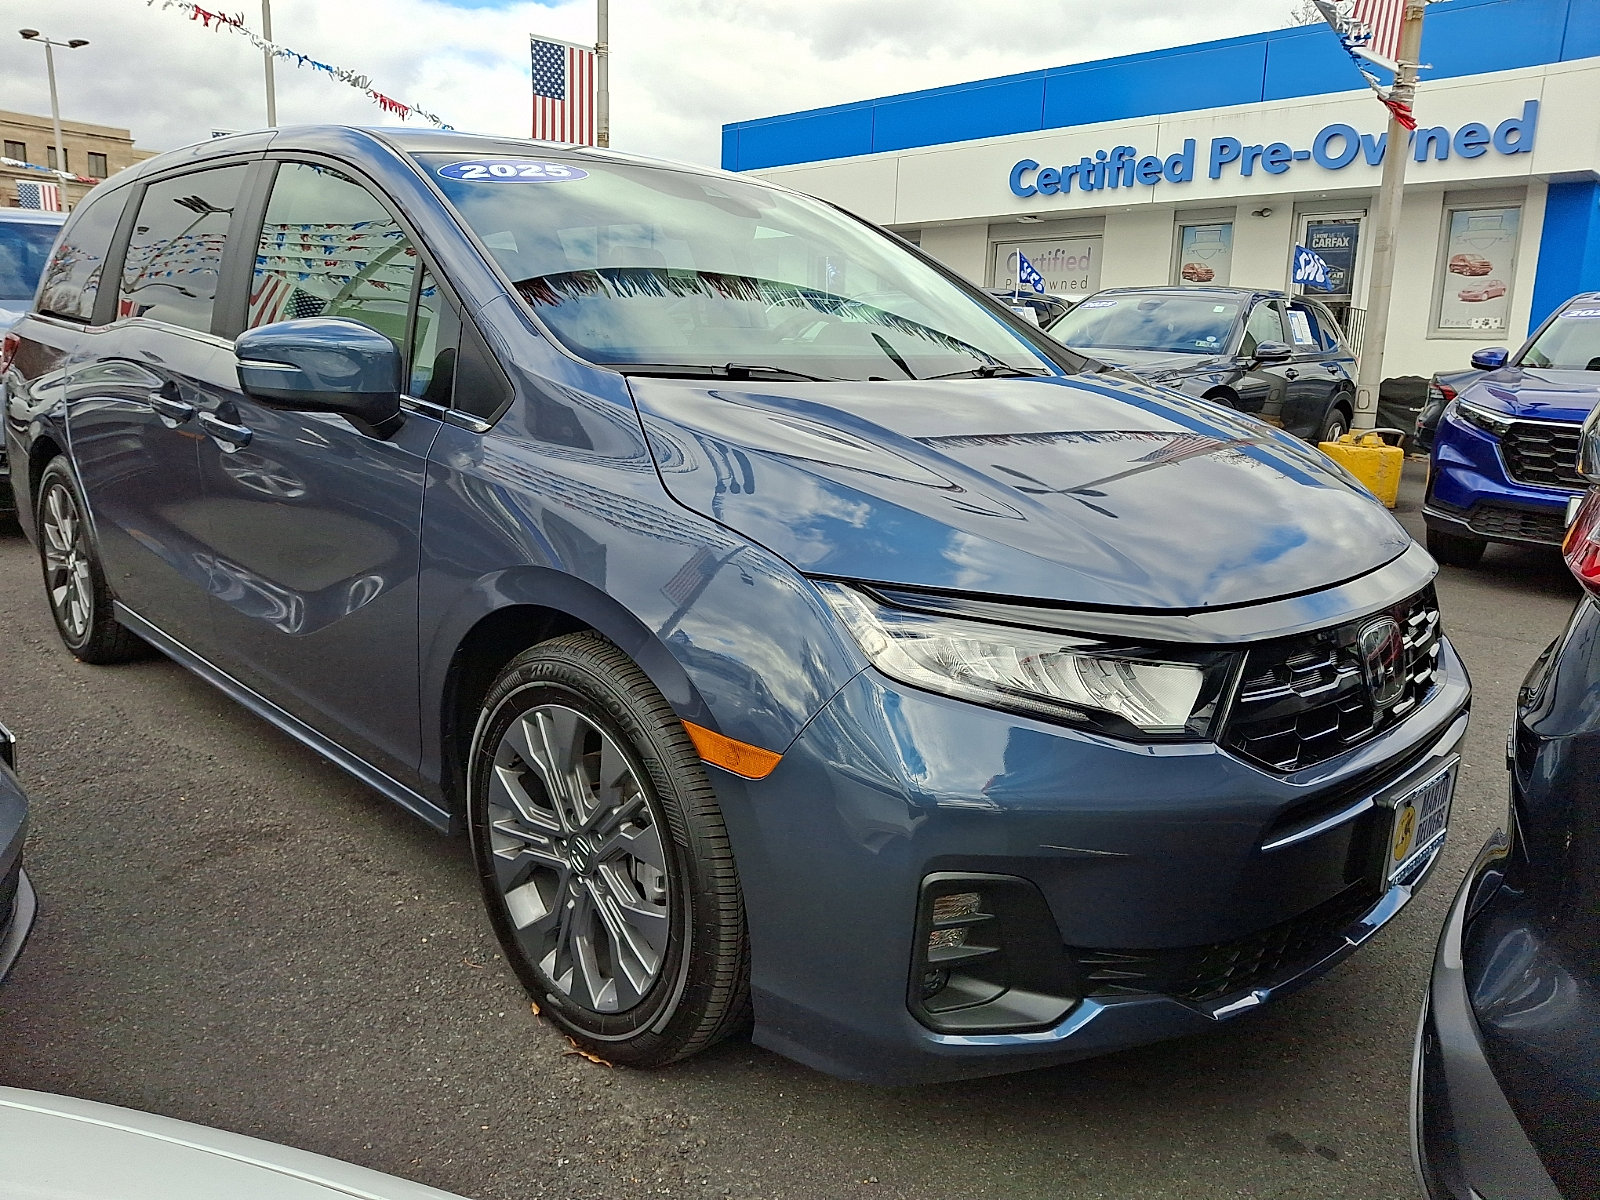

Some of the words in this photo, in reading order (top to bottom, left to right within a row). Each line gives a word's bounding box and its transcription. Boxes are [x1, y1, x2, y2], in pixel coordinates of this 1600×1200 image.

[1009, 138, 1196, 197] Certified
[1209, 99, 1539, 180] Pre-Owned
[459, 164, 572, 179] 2025
[1312, 237, 1350, 248] CARFAX
[1006, 247, 1091, 274] Crtified
